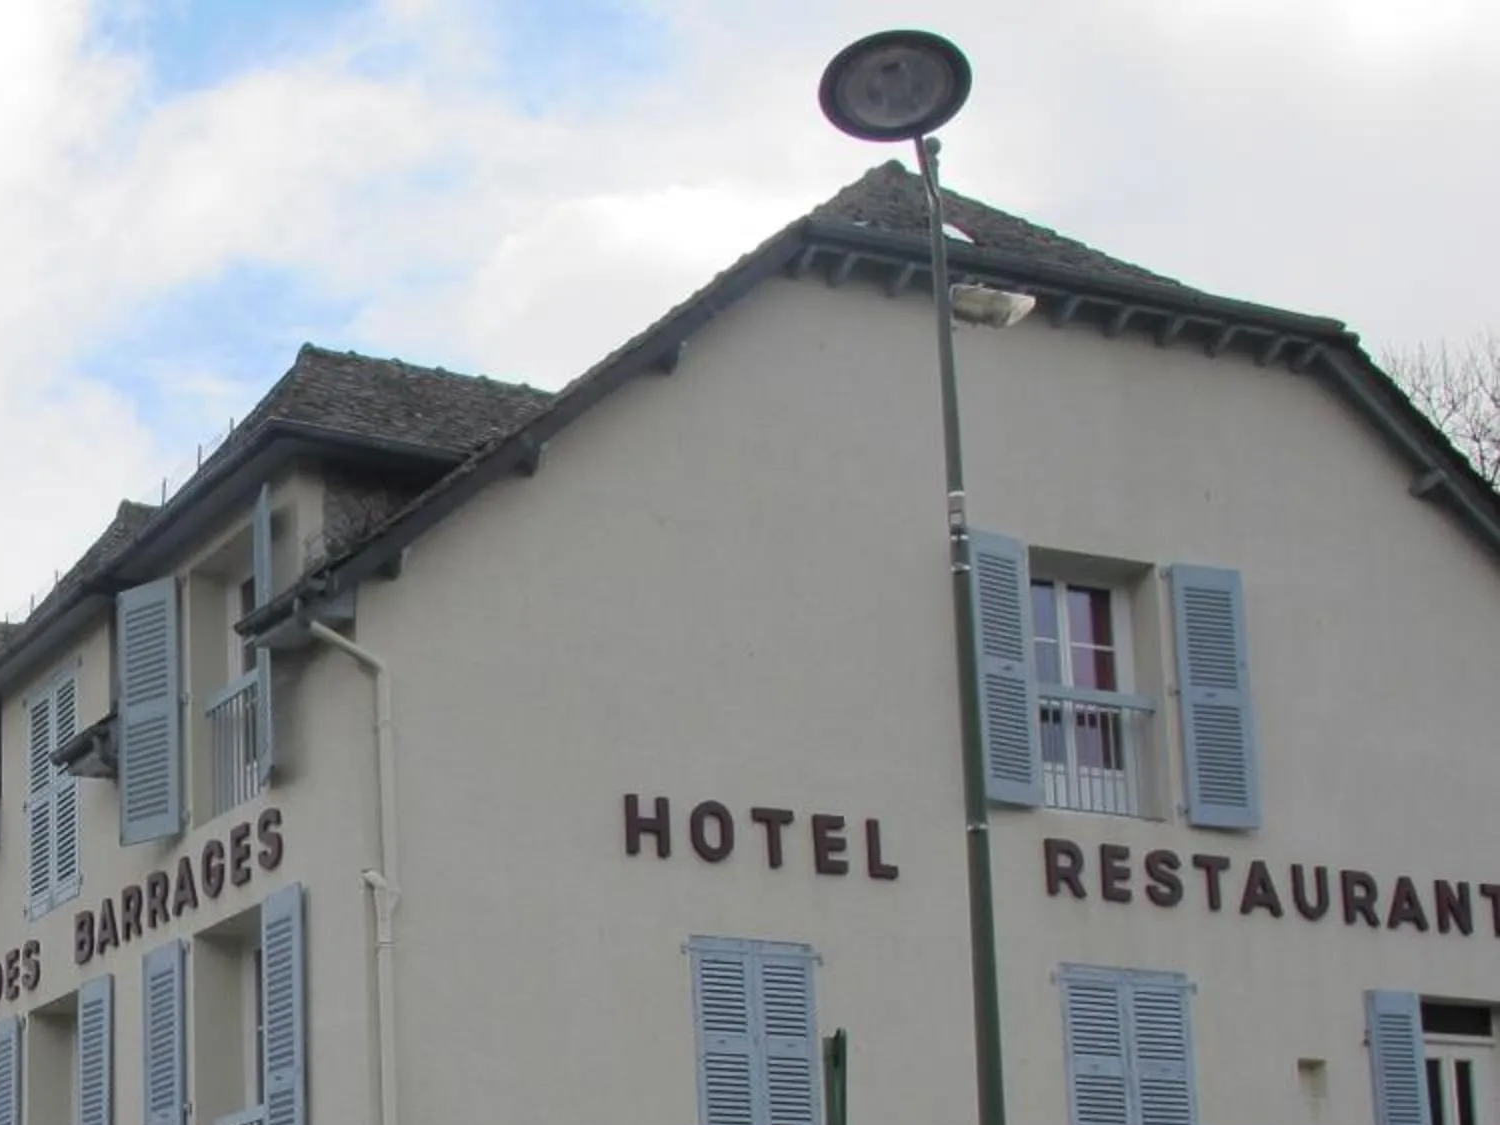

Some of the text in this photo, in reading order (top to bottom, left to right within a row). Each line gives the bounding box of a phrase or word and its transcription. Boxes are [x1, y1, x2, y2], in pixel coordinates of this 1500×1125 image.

[73, 807, 285, 966] BARRAGES
[624, 794, 1500, 939] HOTEL RESTAURANT
